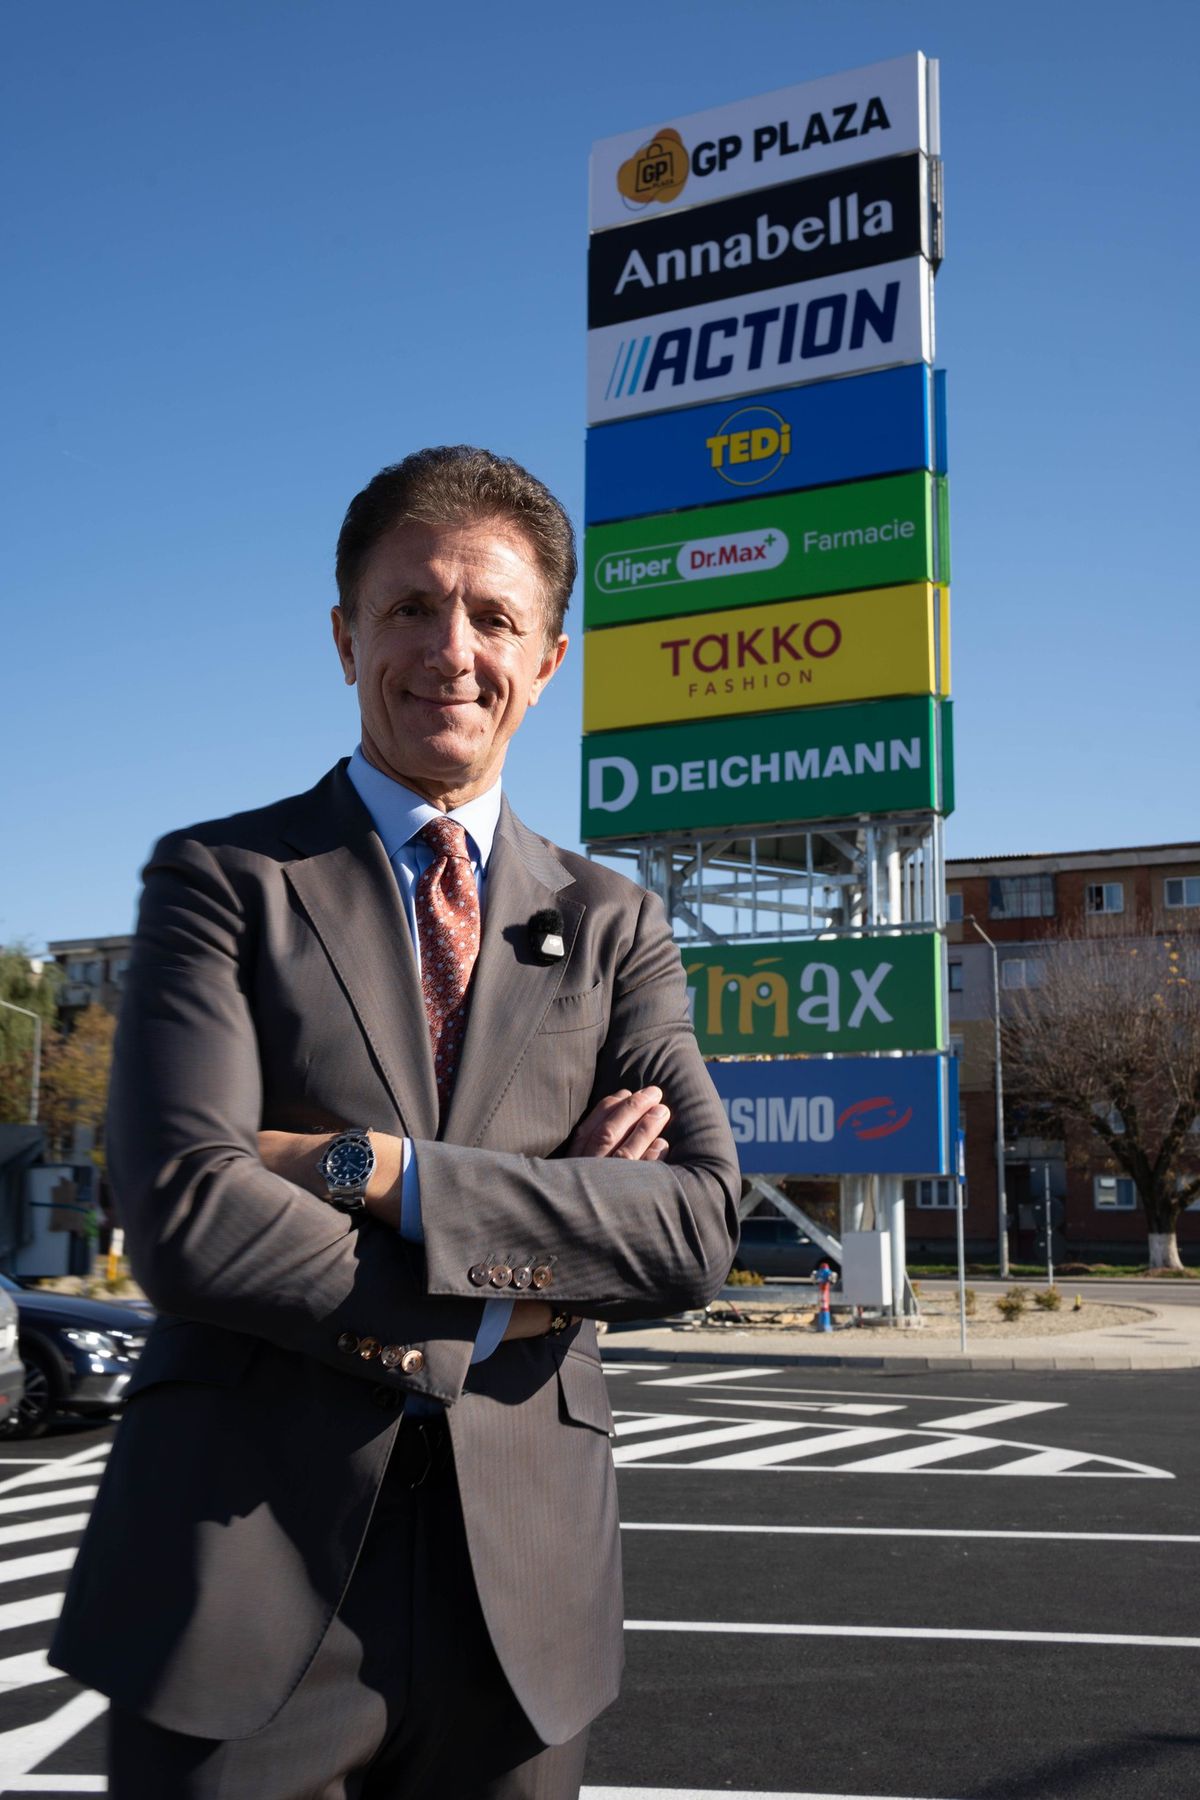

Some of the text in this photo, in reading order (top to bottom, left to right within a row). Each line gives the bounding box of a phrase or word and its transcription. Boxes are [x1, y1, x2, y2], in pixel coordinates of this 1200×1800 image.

[691, 96, 891, 177] GP PLAZA
[642, 161, 668, 184] GP
[613, 192, 894, 295] Annabella
[642, 281, 900, 392] ACTION
[605, 557, 671, 585] Hiper
[803, 519, 915, 552] Farmacie
[689, 669, 812, 697] FASHION
[588, 737, 921, 812] D DEICHMANN
[721, 1096, 835, 1143] SIMO
